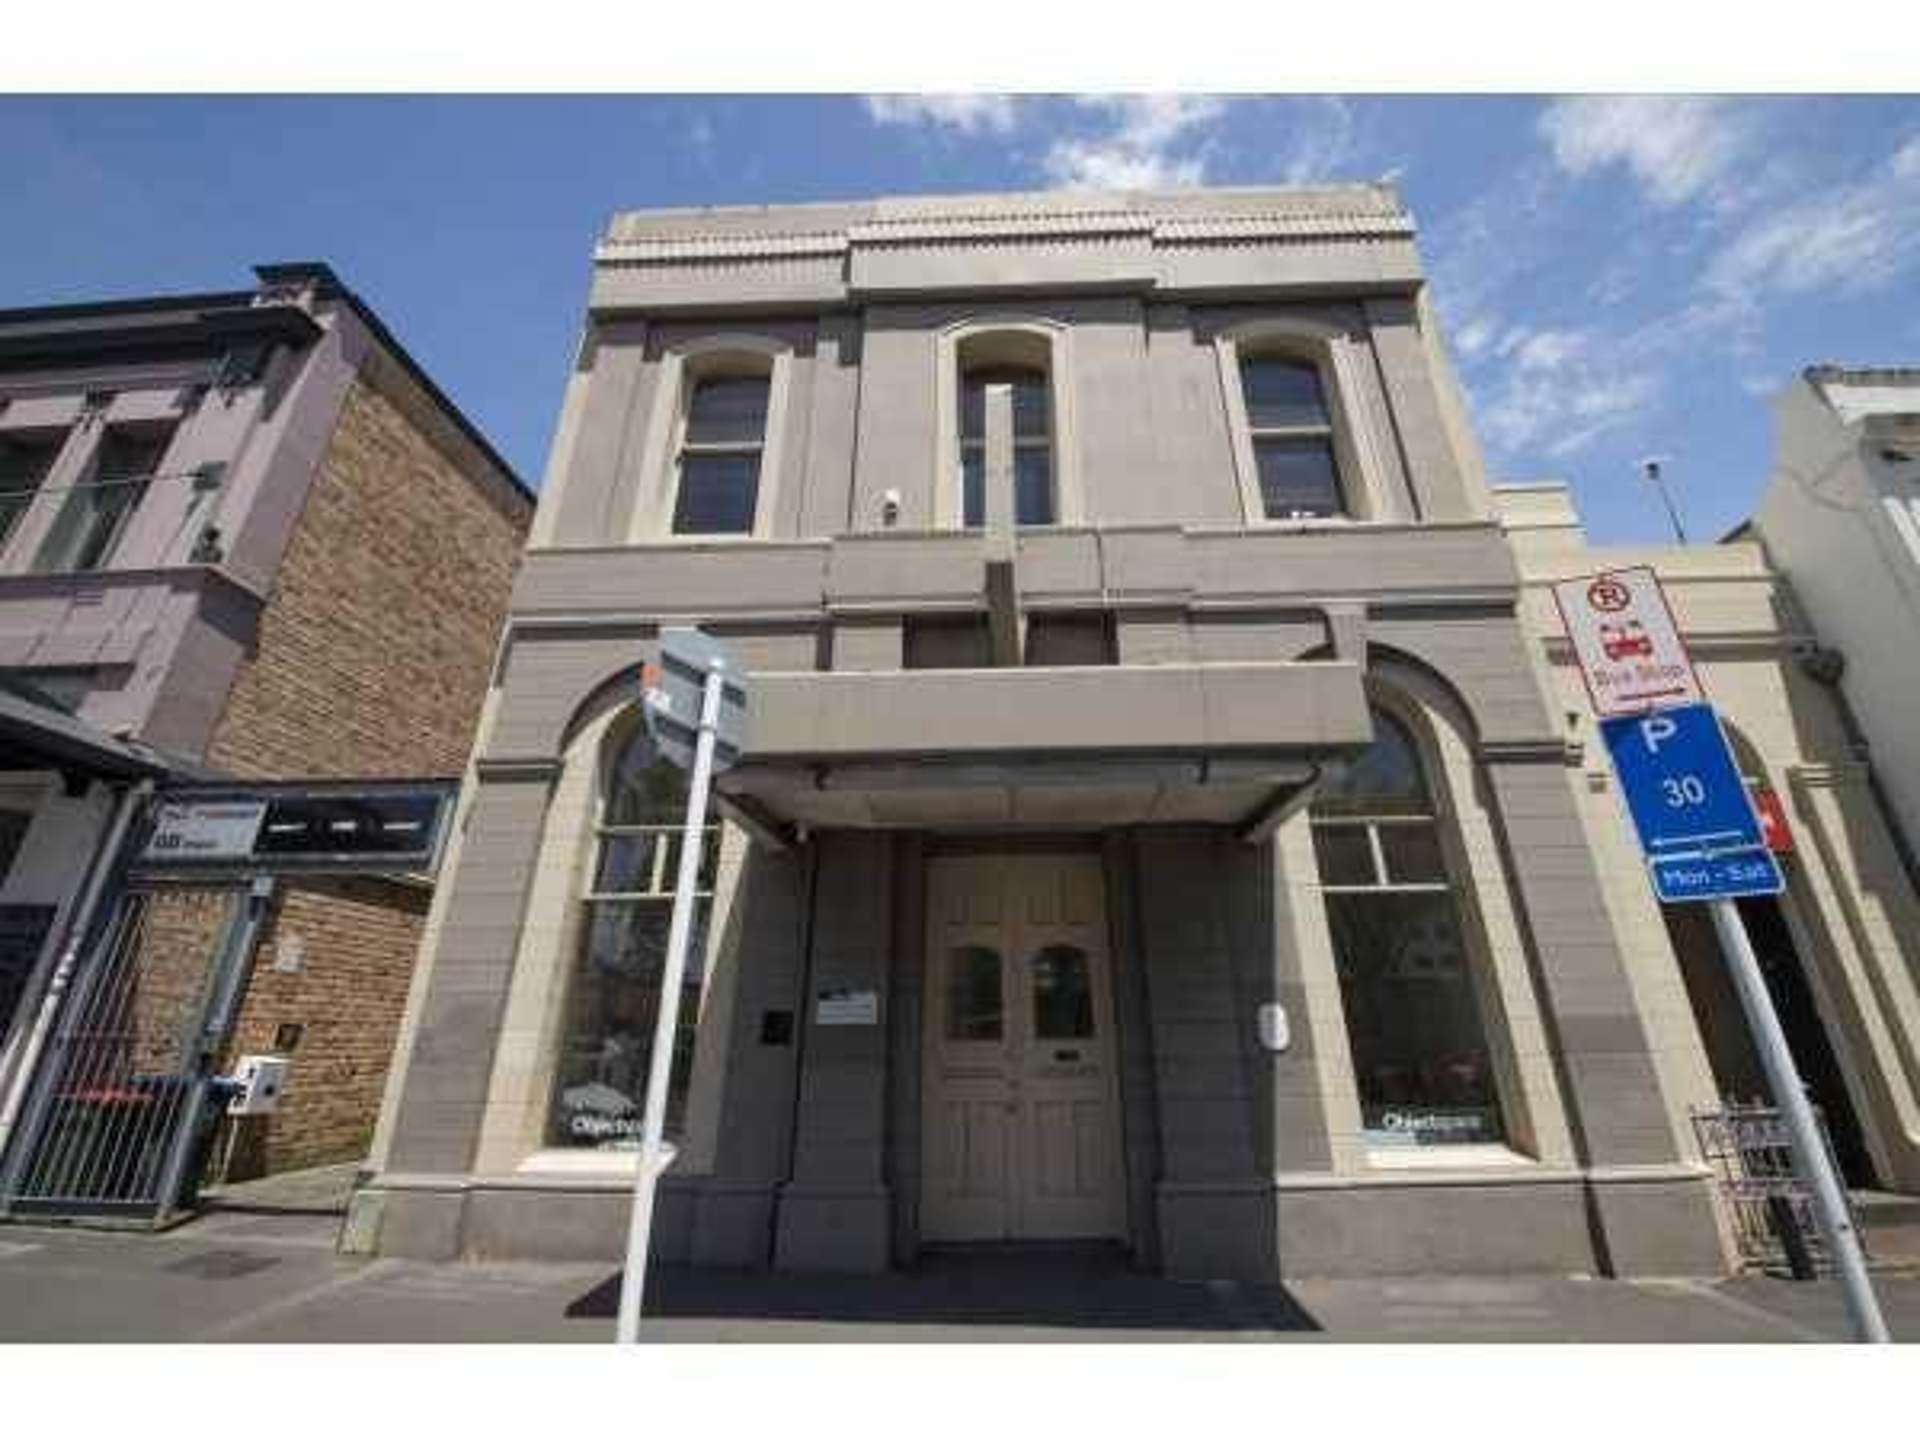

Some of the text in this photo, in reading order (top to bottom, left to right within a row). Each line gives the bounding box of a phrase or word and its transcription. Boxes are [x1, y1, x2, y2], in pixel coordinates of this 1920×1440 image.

[1640, 716, 1678, 754] P
[1663, 775, 1705, 808] 30
[1662, 868, 1711, 888] Mon
[1727, 860, 1770, 882] Sat
